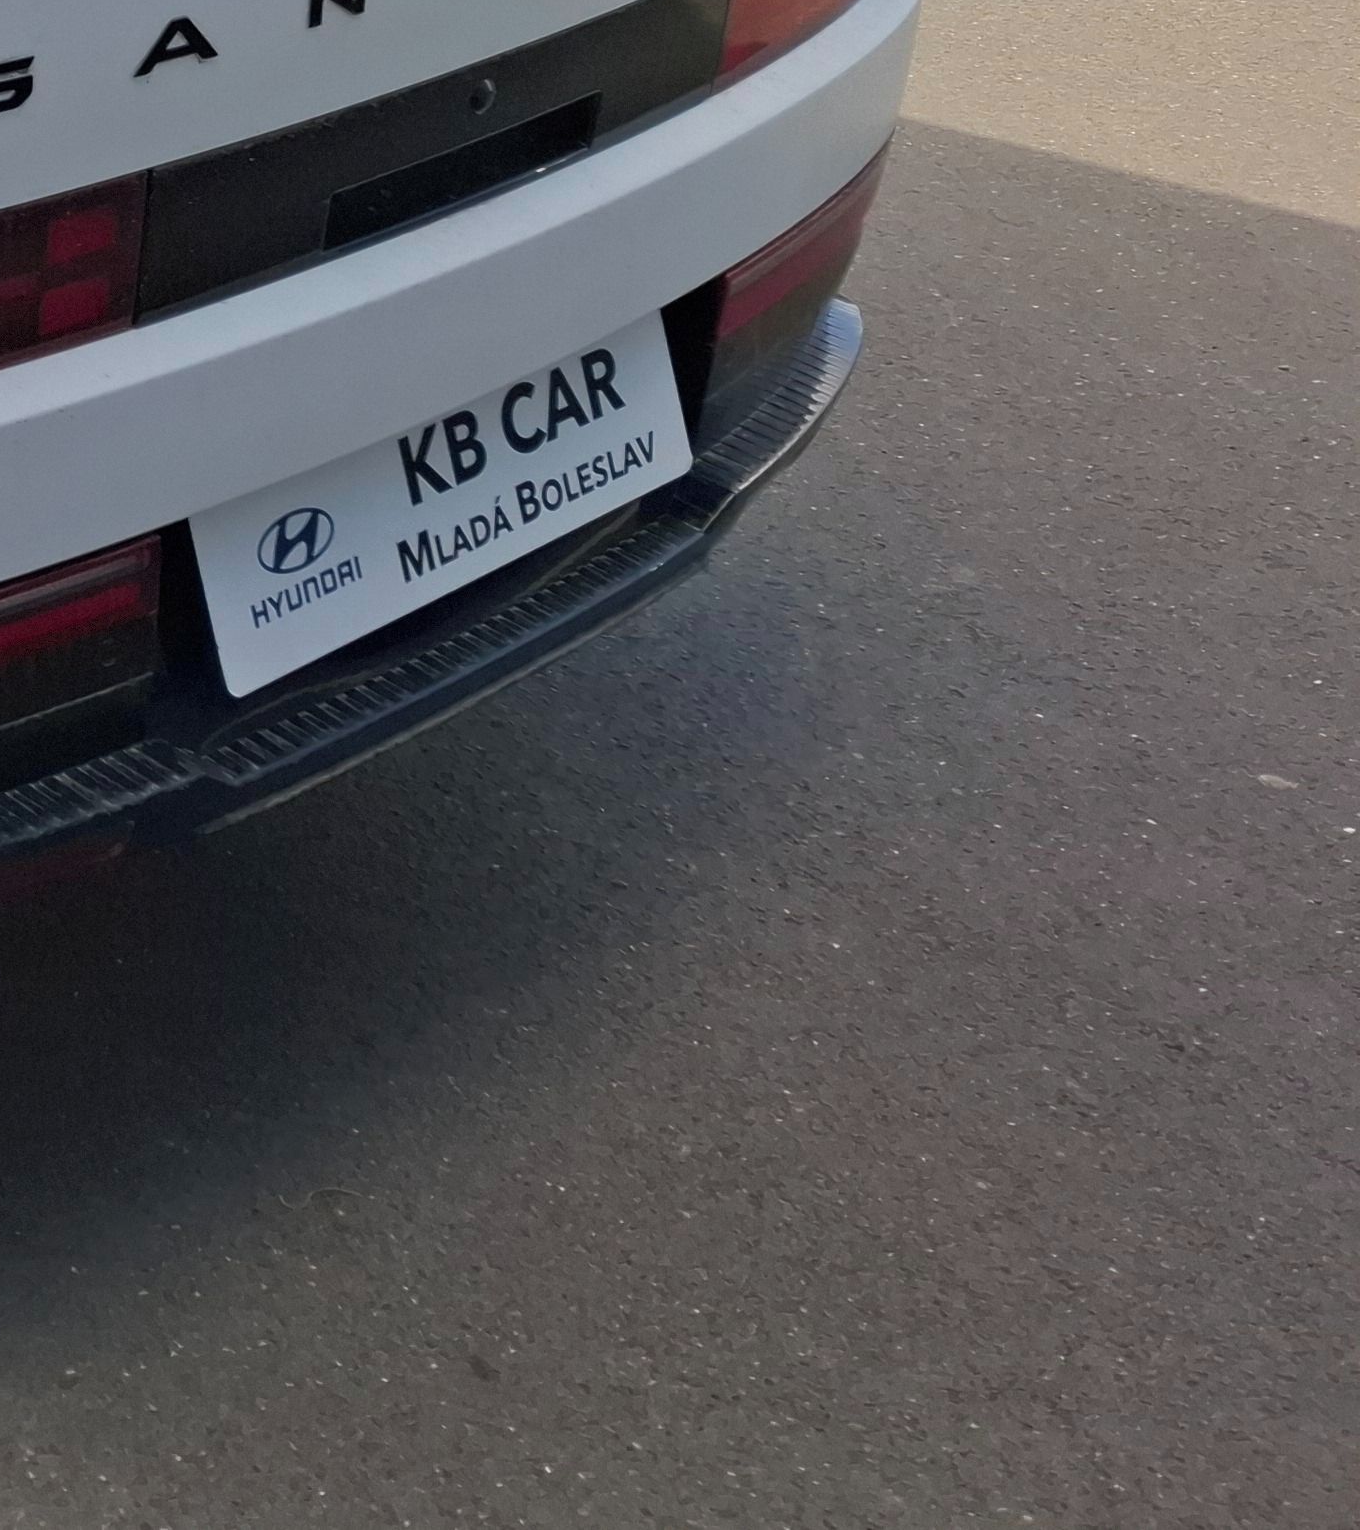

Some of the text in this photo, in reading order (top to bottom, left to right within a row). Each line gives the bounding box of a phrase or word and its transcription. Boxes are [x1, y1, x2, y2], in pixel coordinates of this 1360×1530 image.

[397, 347, 626, 506] KB CAR
[250, 555, 363, 630] HYUNDAI
